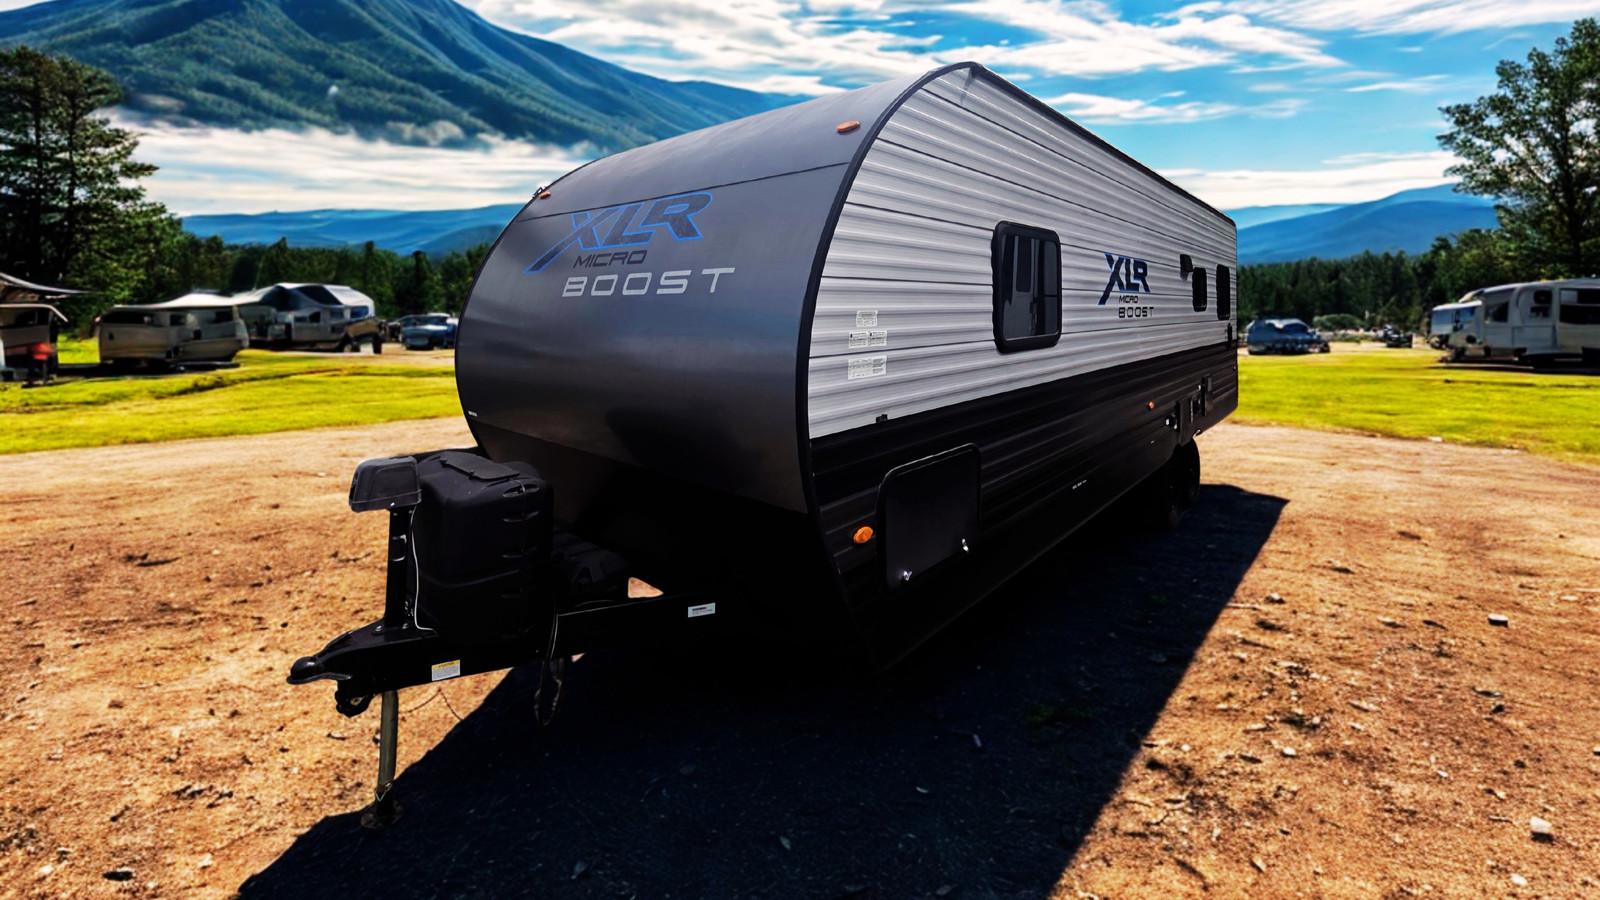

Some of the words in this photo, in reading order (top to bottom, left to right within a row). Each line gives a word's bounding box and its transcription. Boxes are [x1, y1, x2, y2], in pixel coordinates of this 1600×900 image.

[523, 192, 713, 275] XLR
[573, 250, 648, 268] MICRO
[562, 267, 735, 298] BOOST
[1098, 252, 1150, 305] XLR
[1118, 295, 1139, 304] MICRO
[1118, 306, 1154, 318] BOOST
